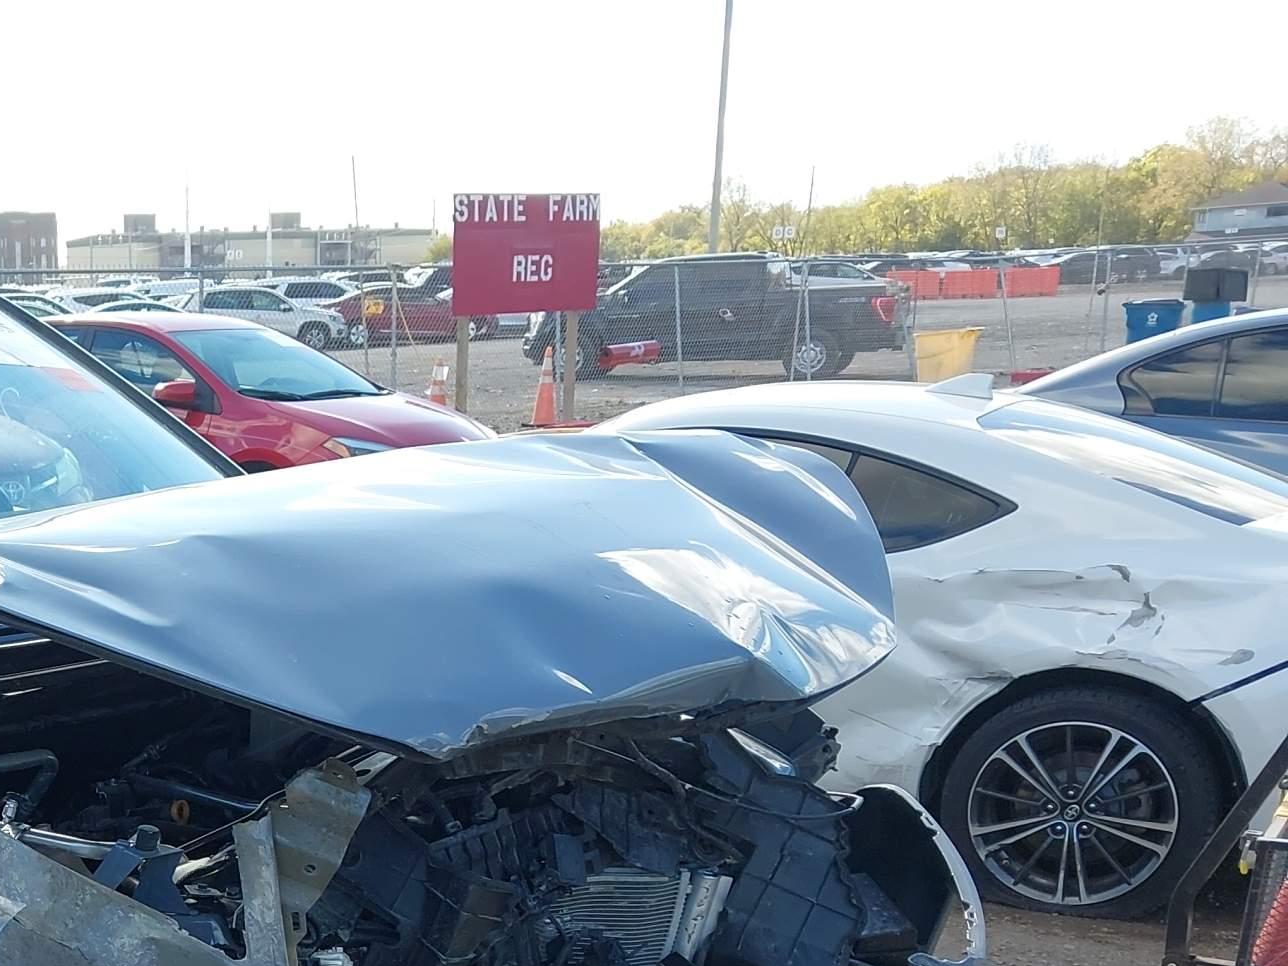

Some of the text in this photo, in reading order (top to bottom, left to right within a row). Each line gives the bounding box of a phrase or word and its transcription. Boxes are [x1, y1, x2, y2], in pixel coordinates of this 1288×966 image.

[454, 194, 600, 222] STATE FARM
[512, 254, 554, 282] REG
